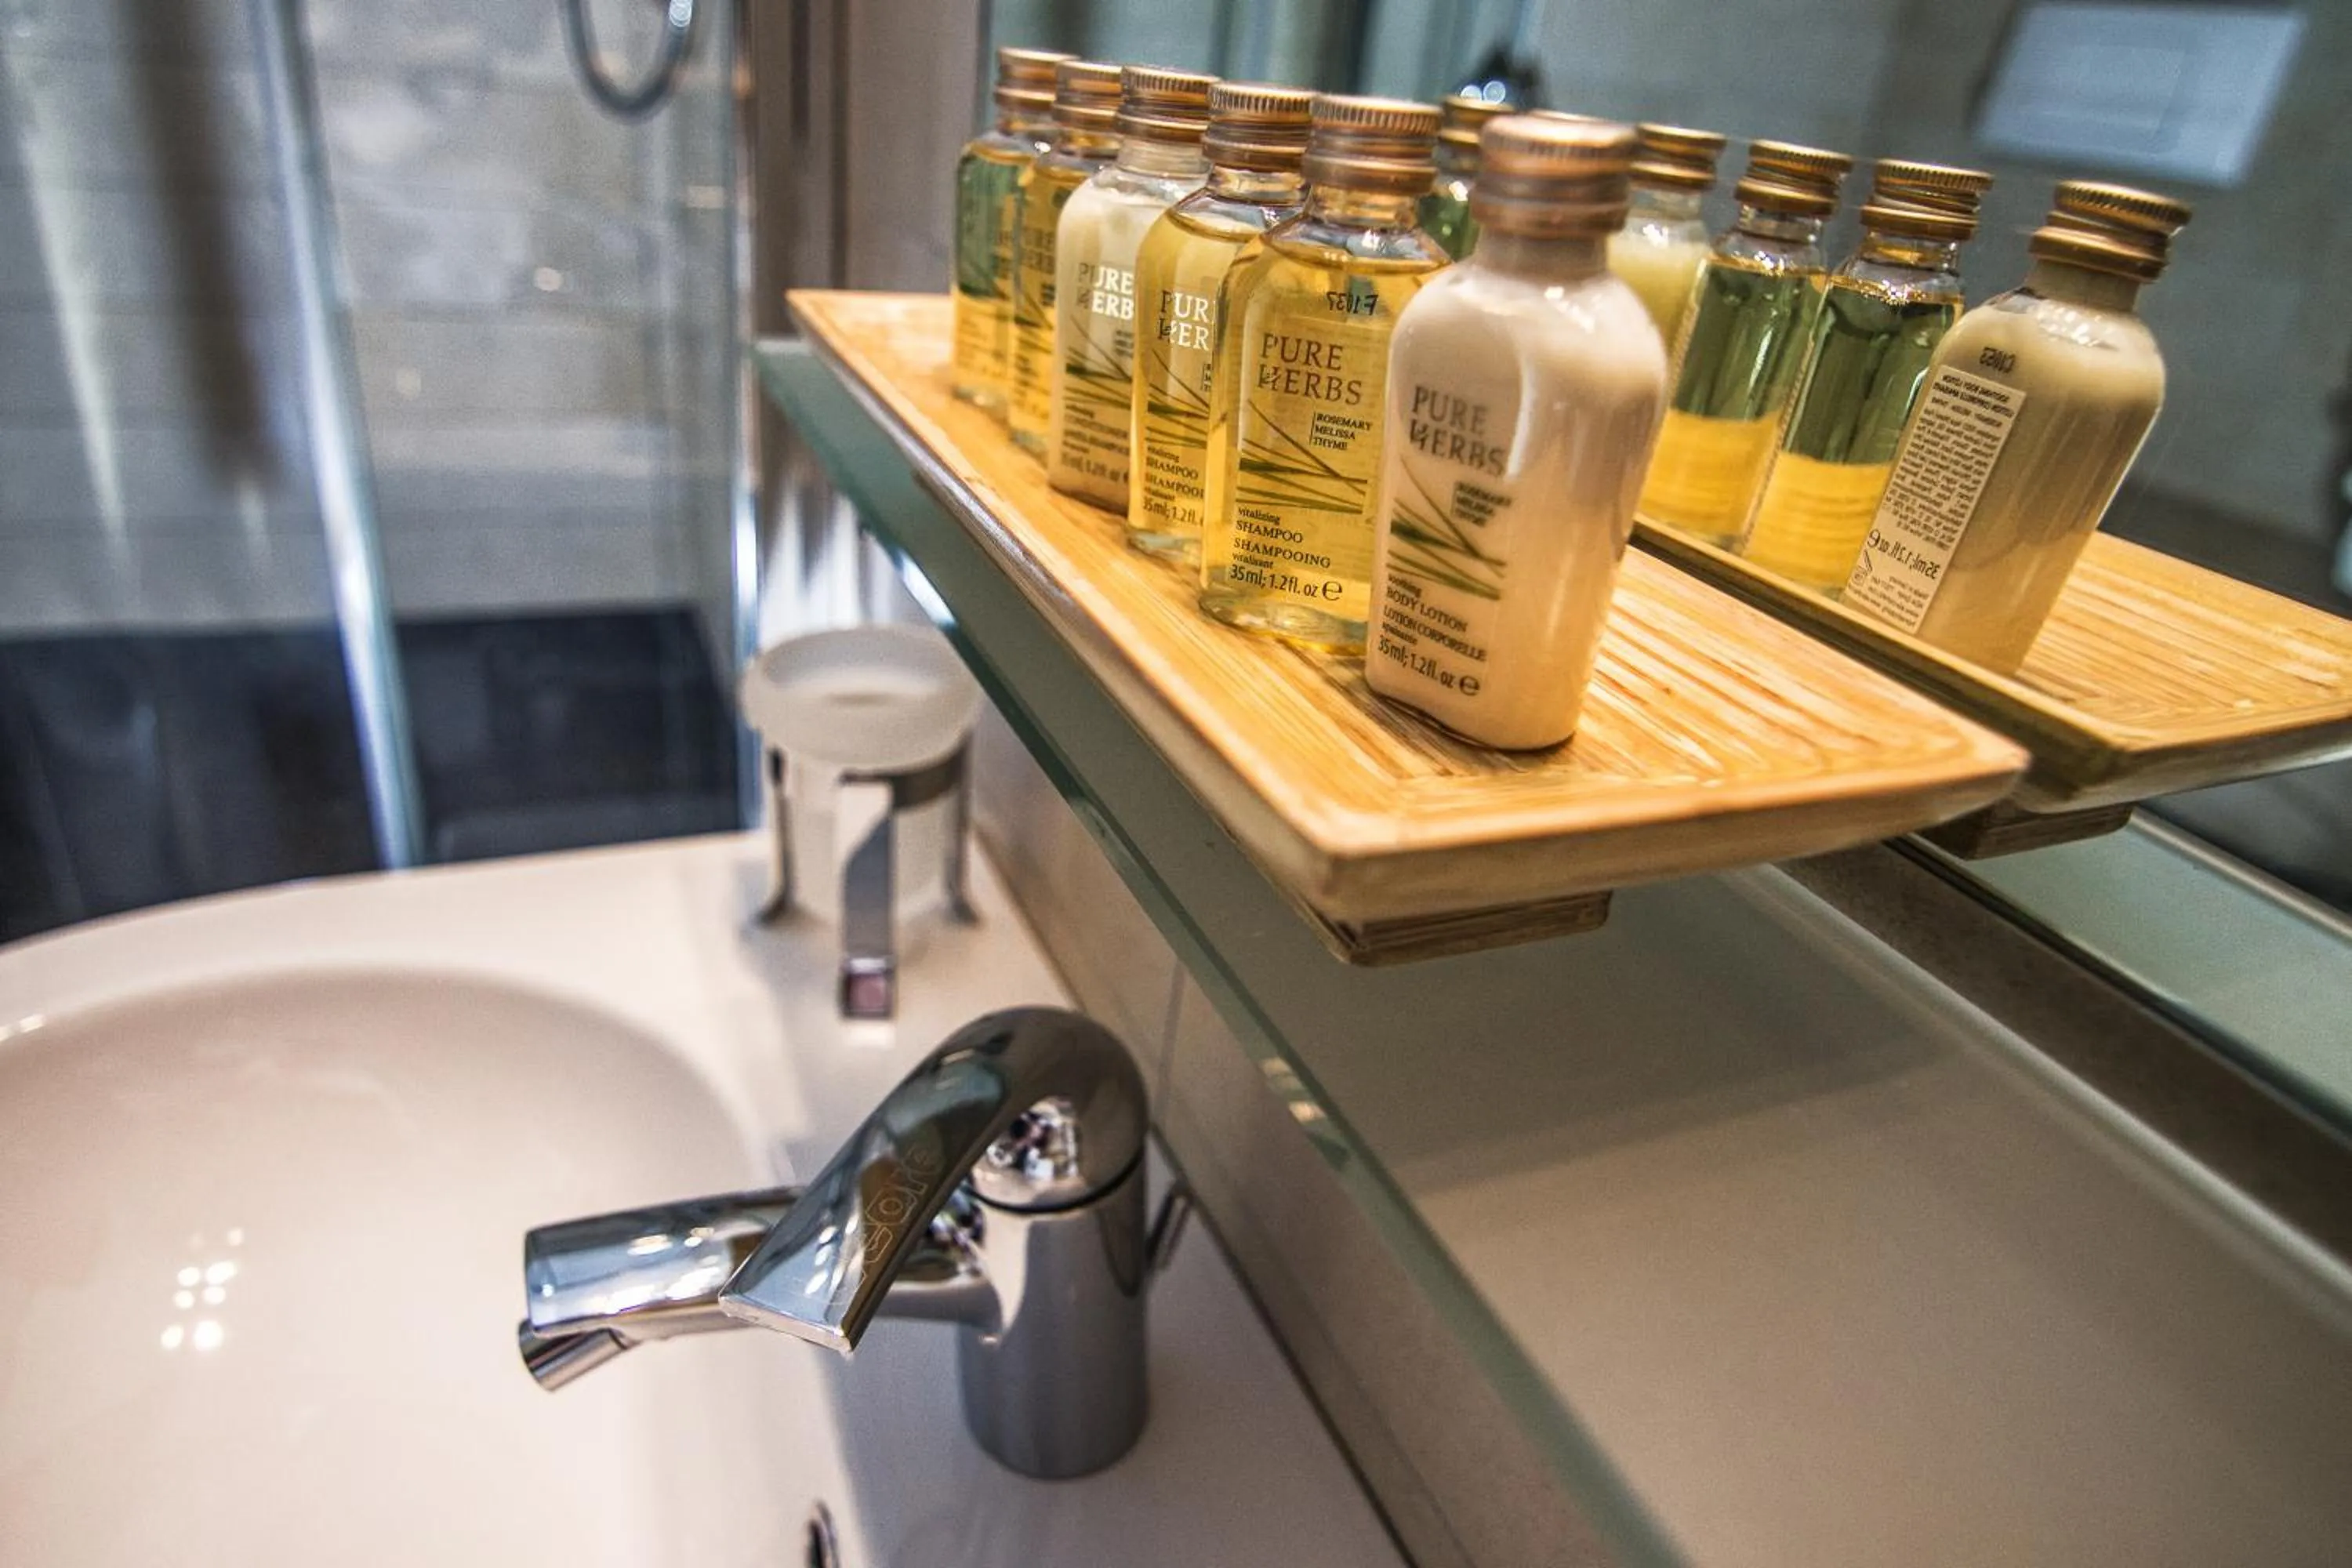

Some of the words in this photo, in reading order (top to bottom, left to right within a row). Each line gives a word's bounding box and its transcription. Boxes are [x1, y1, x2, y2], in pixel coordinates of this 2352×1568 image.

[1078, 262, 1134, 294] PURE
[1161, 290, 1215, 323] PUR
[1157, 318, 1210, 351] HER
[1260, 332, 1345, 372] PURE
[1256, 363, 1363, 406] HERBS
[1316, 413, 1374, 432] ROSEMARY
[1411, 385, 1489, 436] PURE
[1313, 436, 1348, 451] THYME
[1314, 424, 1356, 441] MELISSA
[1410, 418, 1505, 477] HERBS
[1236, 520, 1304, 543] SHAMPOO
[1233, 537, 1331, 568] SHAMPOOING
[1269, 573, 1301, 595] 1.2fl.
[1304, 583, 1319, 598] oz
[1383, 604, 1417, 630] LOTION
[1386, 586, 1418, 611] BODY
[1420, 603, 1468, 633] LOTION
[1440, 670, 1457, 688] oz
